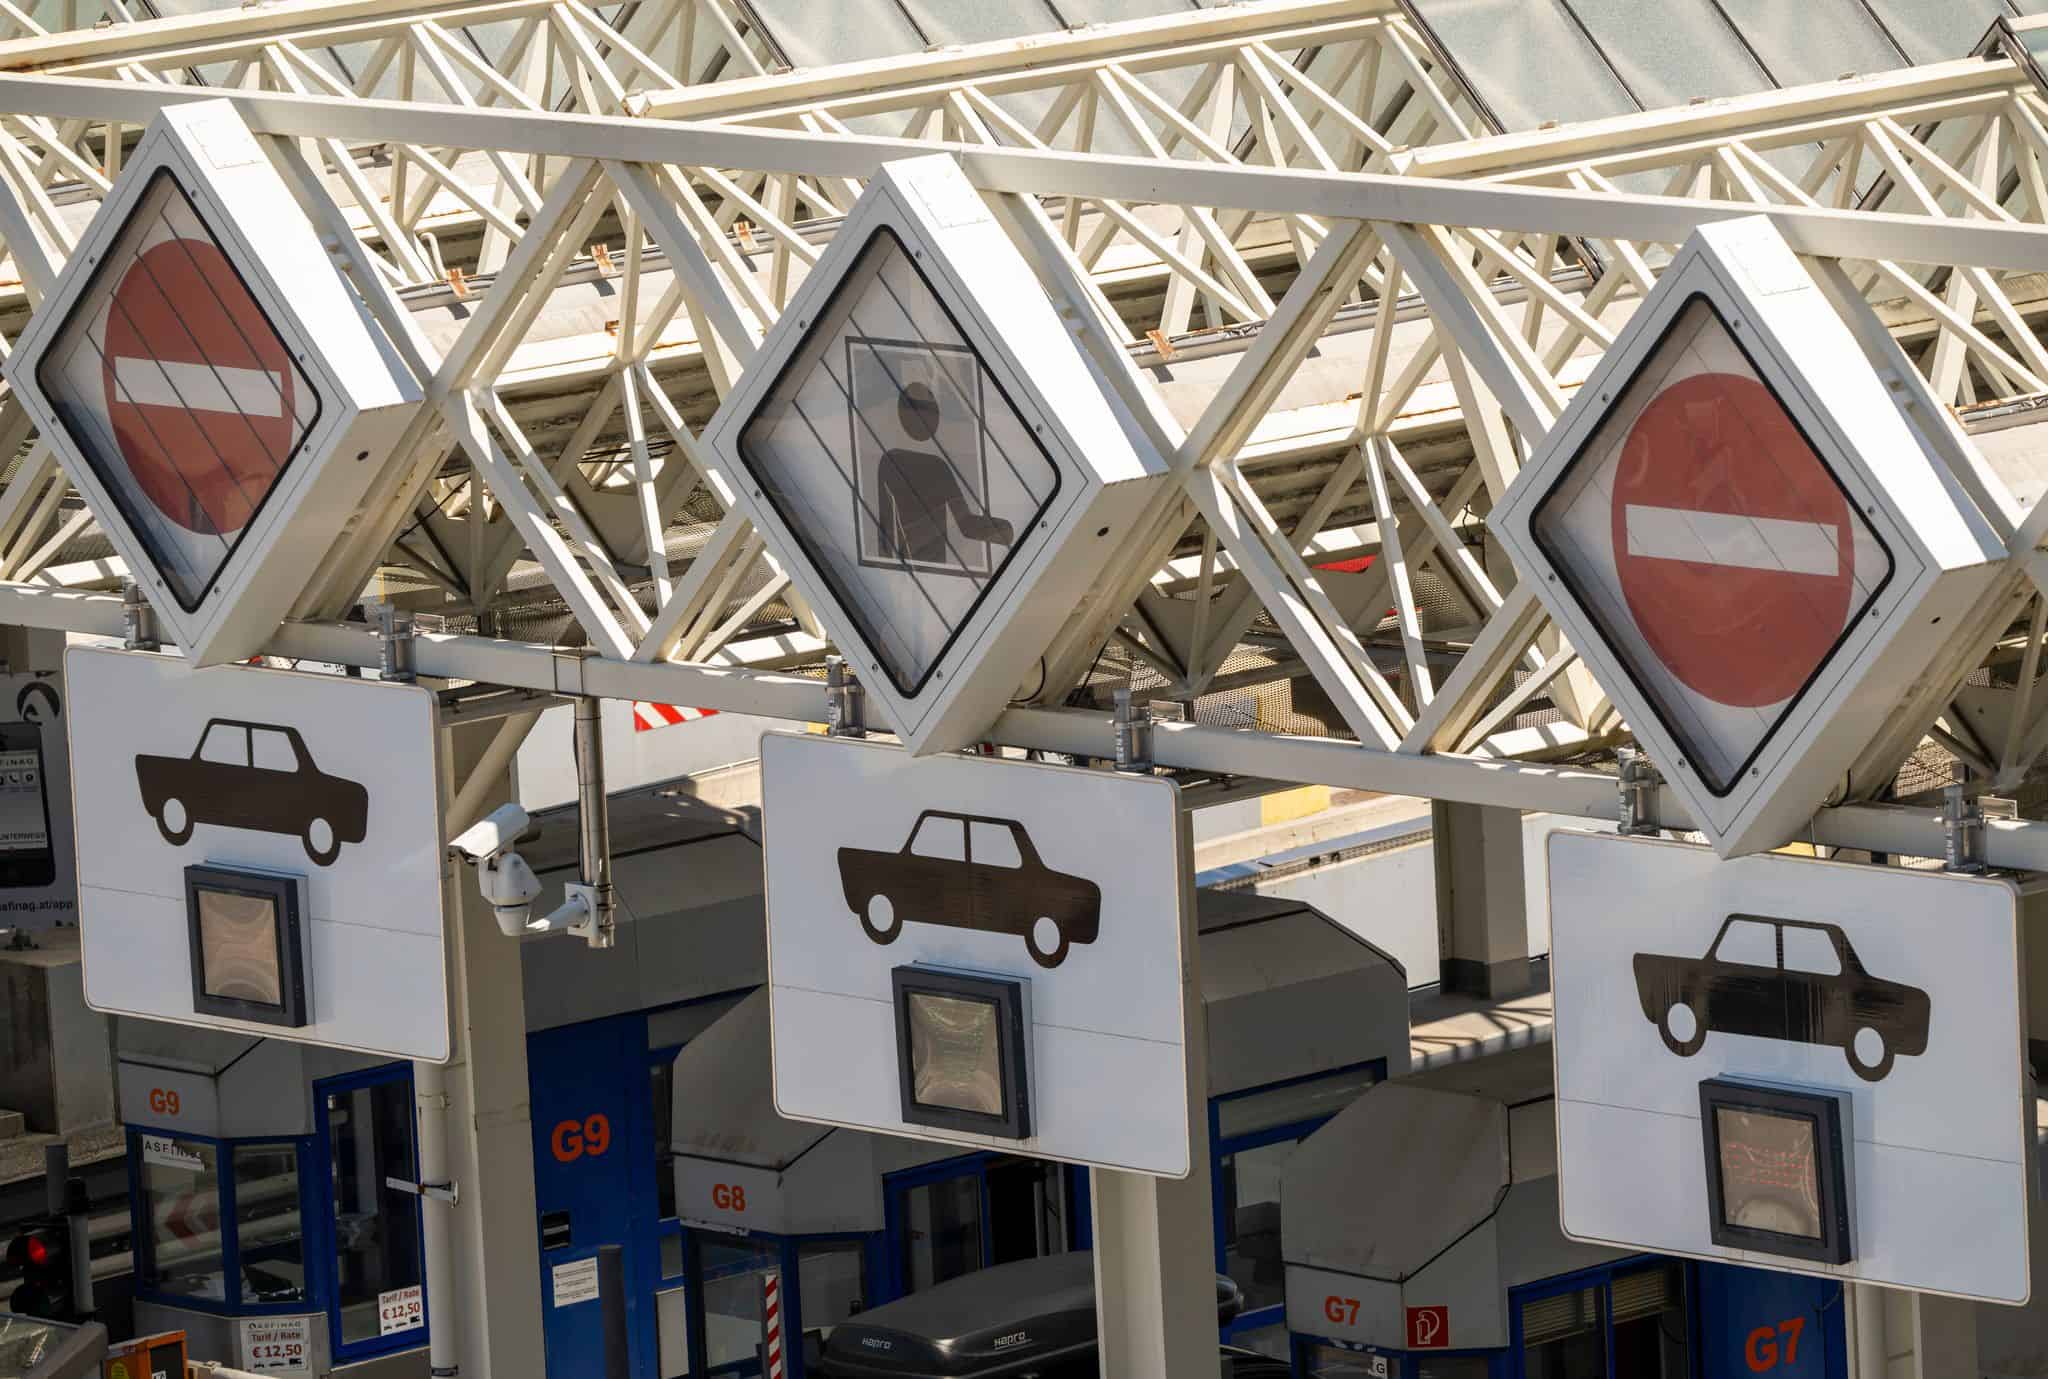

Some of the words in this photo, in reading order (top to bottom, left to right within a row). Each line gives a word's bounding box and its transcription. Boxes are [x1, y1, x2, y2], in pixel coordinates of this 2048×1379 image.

[150, 1087, 180, 1115] G9
[551, 1113, 610, 1163] G9
[712, 1183, 746, 1212] G8
[392, 1302, 420, 1318] 12,50
[1325, 1295, 1360, 1326] G7
[264, 1344, 302, 1358] 12,50
[1745, 1316, 1806, 1373] G7
